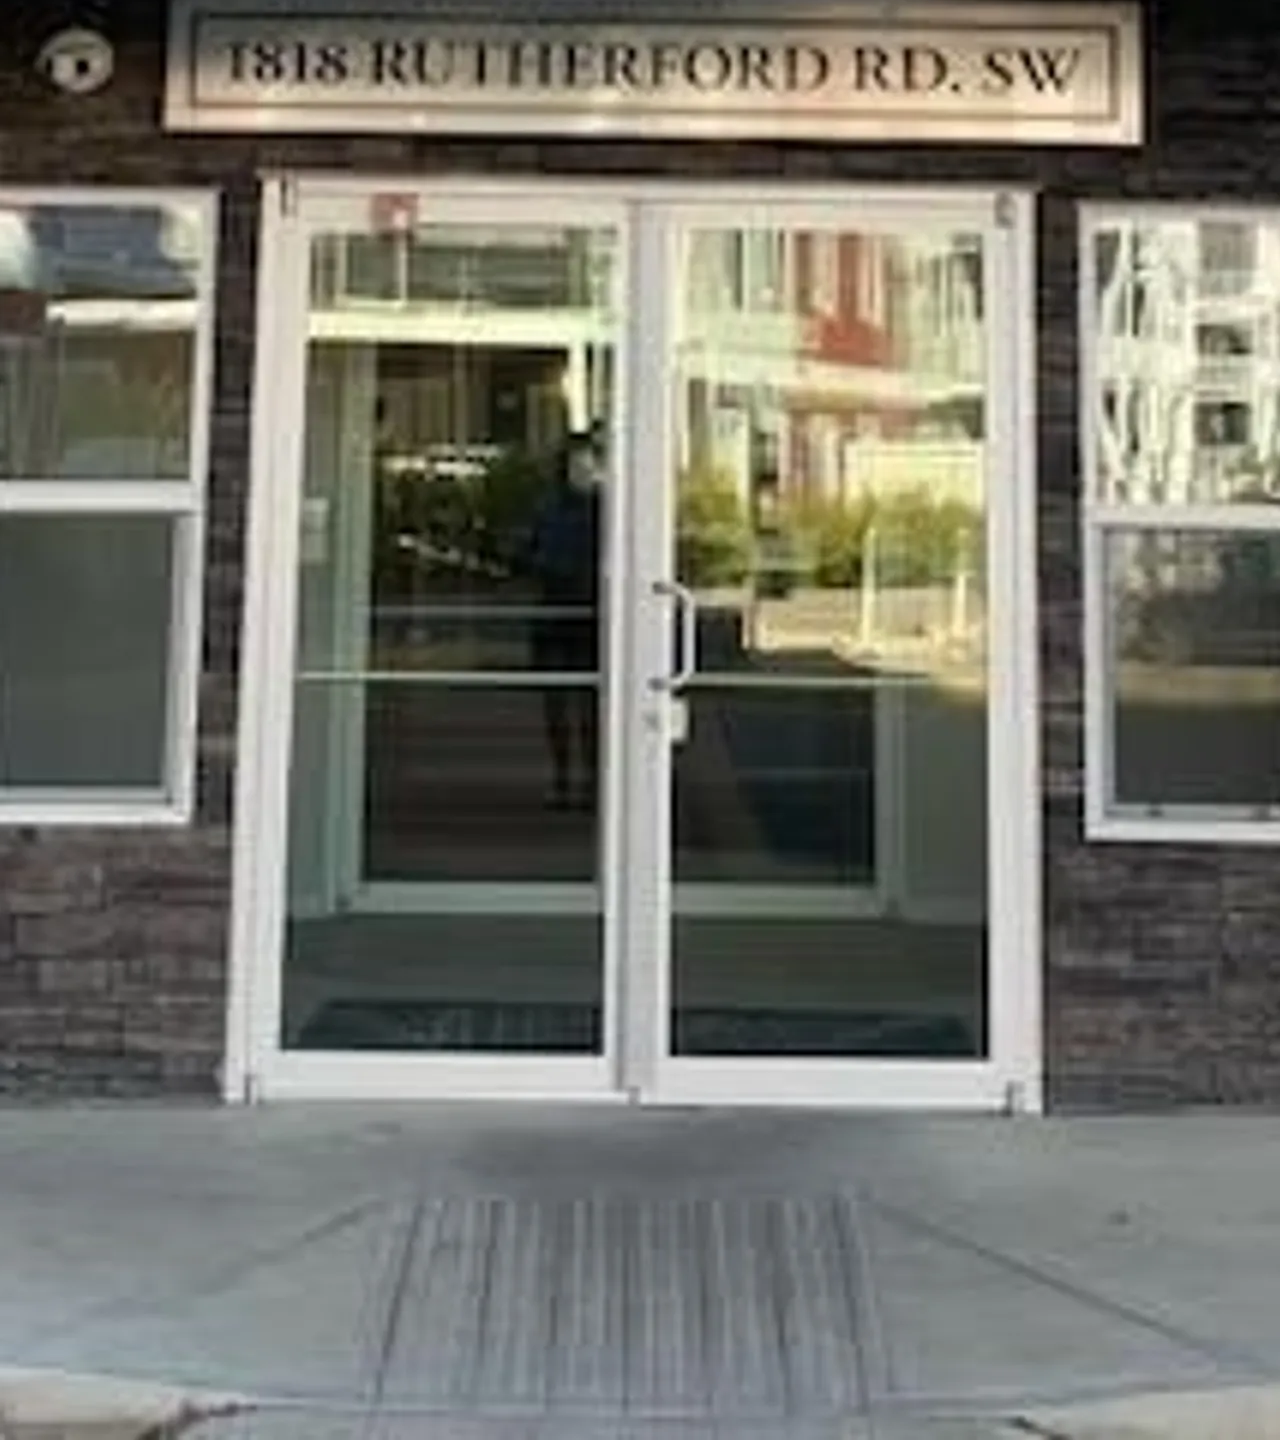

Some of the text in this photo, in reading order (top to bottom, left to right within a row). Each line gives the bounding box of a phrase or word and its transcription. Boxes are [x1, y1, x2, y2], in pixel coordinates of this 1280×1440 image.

[228, 41, 1081, 96] 1818 RUTHERFORD RD. SW
